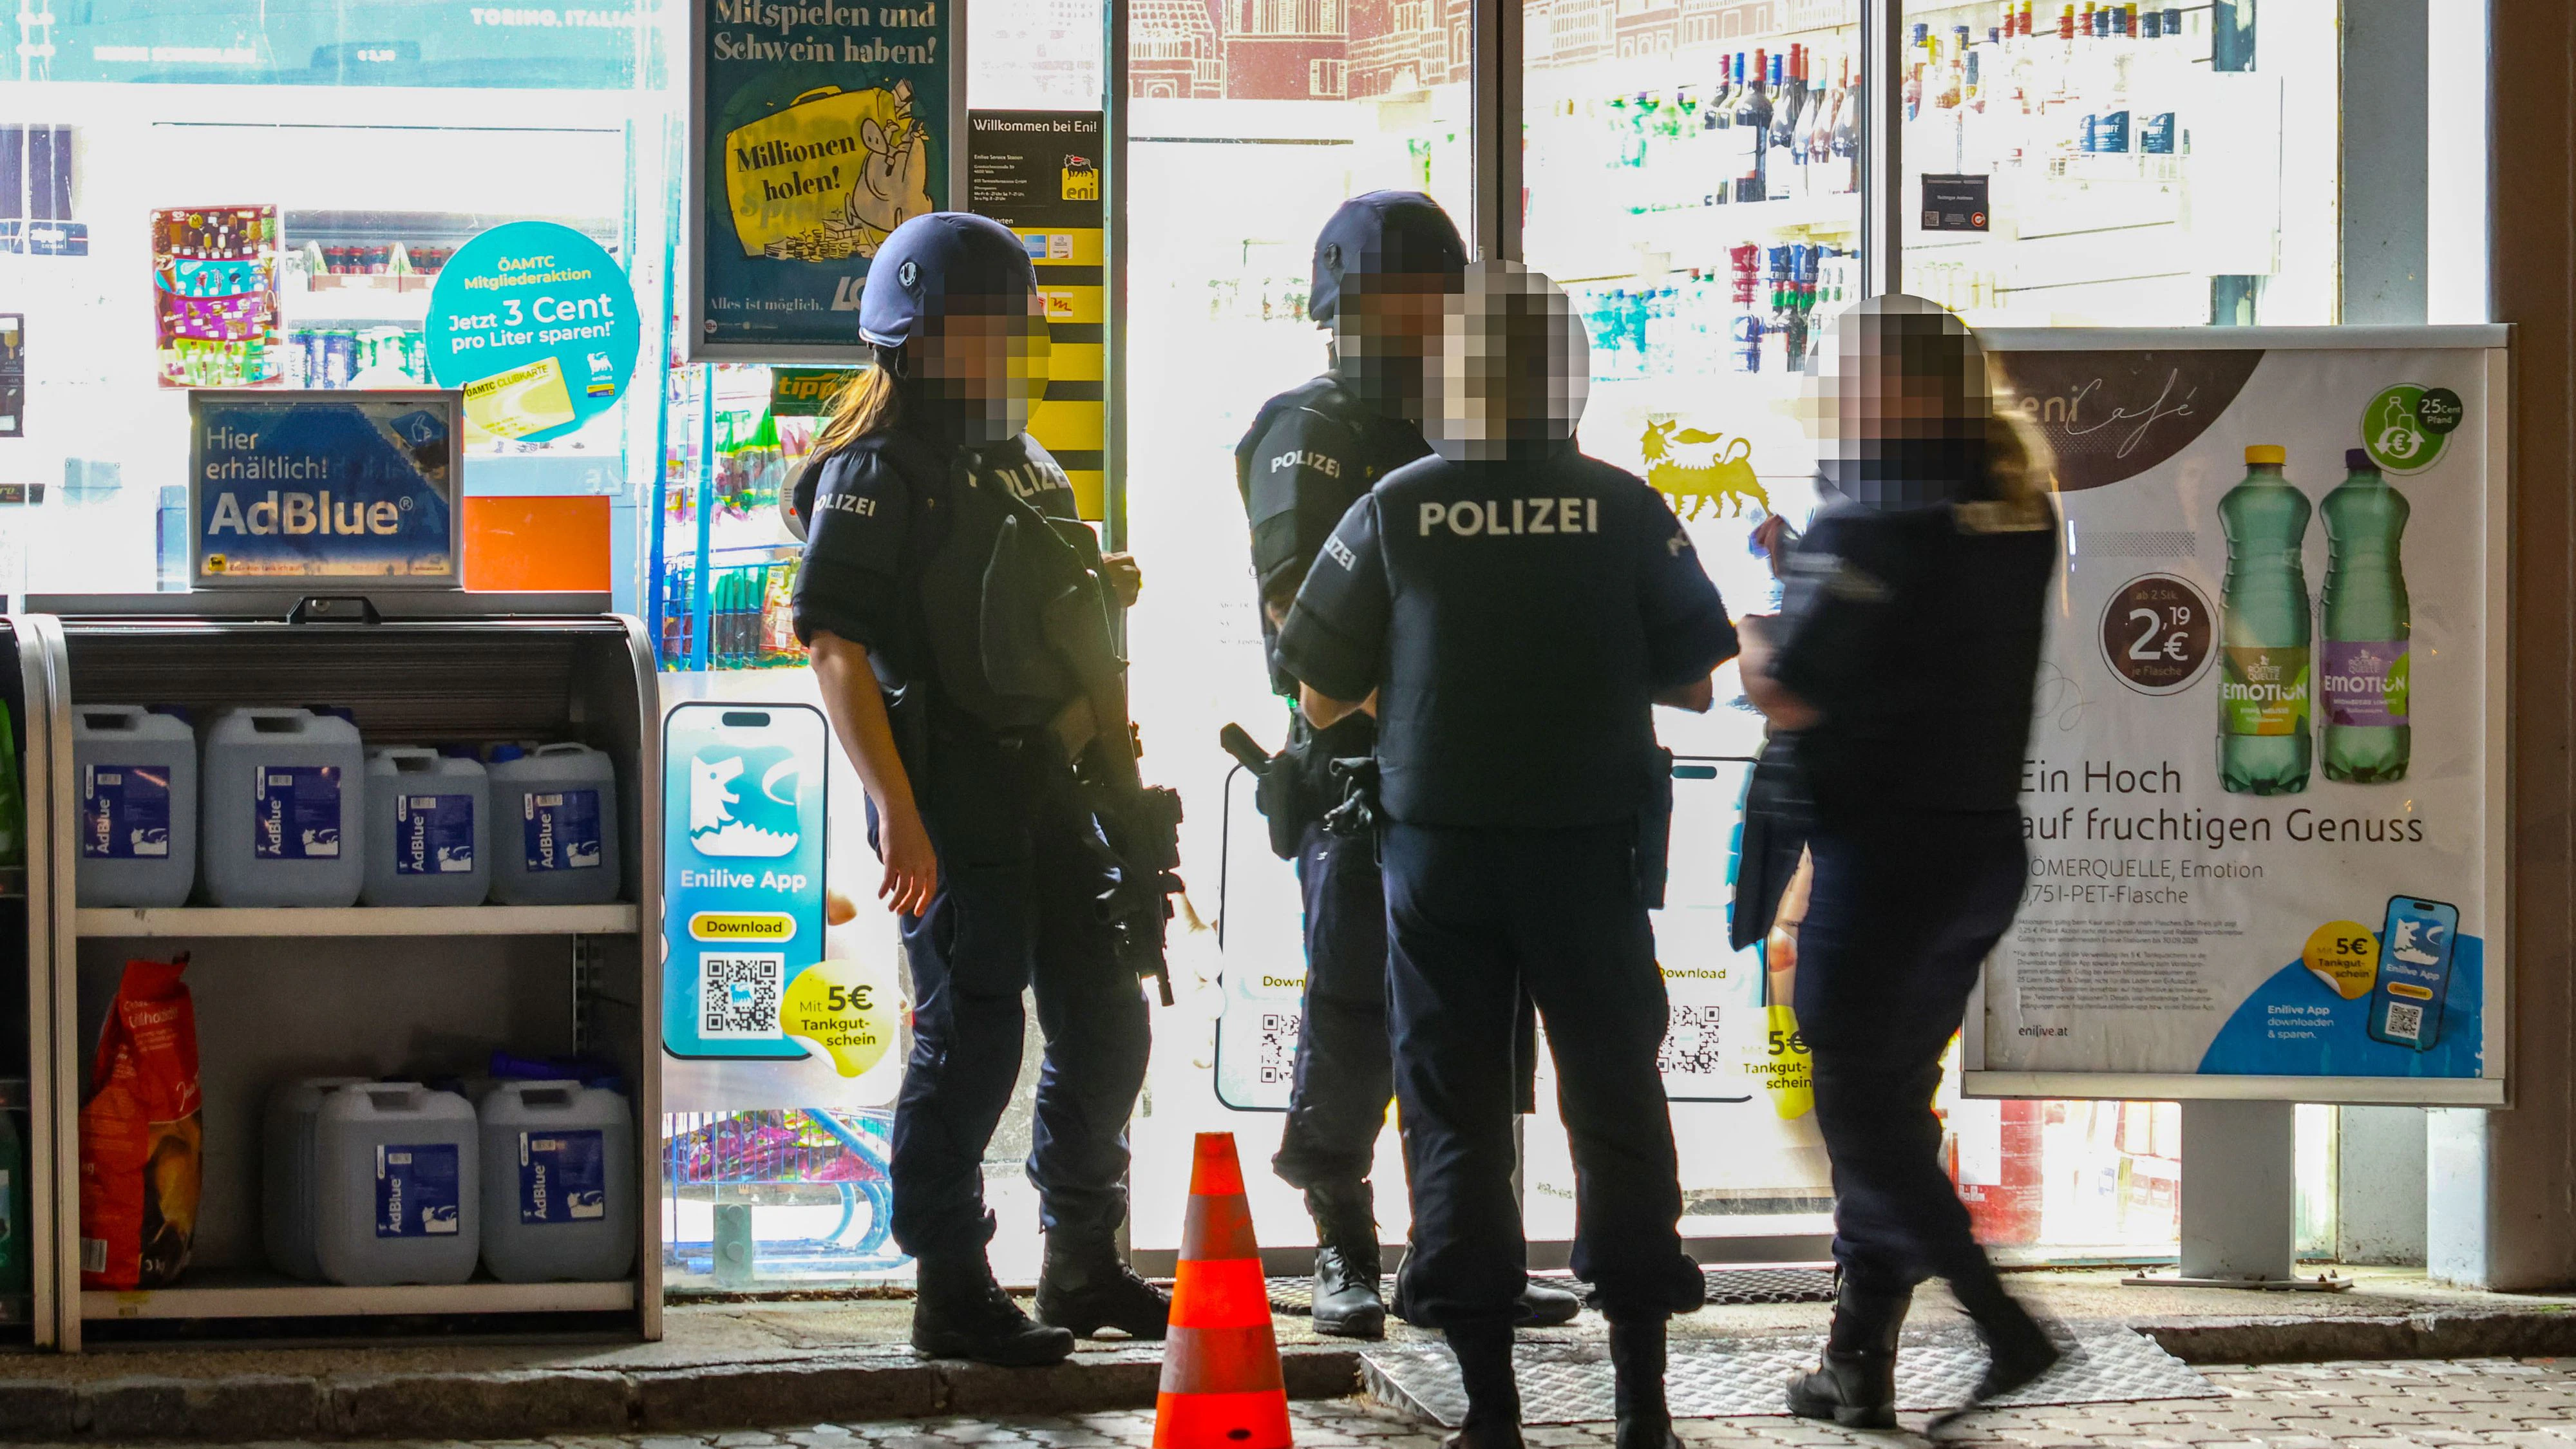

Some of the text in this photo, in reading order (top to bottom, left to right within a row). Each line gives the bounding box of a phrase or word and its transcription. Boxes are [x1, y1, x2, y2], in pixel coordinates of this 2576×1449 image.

[715, 0, 937, 35] Mitspielen und
[714, 32, 937, 64] Schwein haben!
[973, 119, 1097, 133] Willkommen bei Eni!
[734, 134, 856, 173] Millionen
[762, 166, 840, 202] holen!
[1066, 182, 1094, 199] eni
[498, 255, 556, 272] ÖAMTC
[464, 268, 592, 290] Mitgliederaktion
[449, 293, 614, 331] Jetzt 3 Cent
[746, 298, 761, 310] ist
[765, 298, 824, 314] möglich.
[451, 336, 486, 354] pro
[489, 329, 535, 348] Liter
[497, 364, 547, 389] CLUBKARTE
[2066, 368, 2196, 459] Café
[2427, 415, 2452, 424] Pfand
[206, 426, 259, 450] Hier
[206, 455, 327, 480] erhältlich!
[813, 491, 876, 518] POLIZEI
[1419, 498, 1598, 537] POLIZEI
[2152, 591, 2157, 599] 2
[2163, 631, 2189, 661] €
[2143, 665, 2182, 676] Flasche
[2248, 673, 2280, 681] QUELLE
[2223, 683, 2307, 701] EMOTION
[2325, 675, 2405, 693] EMOTION
[2021, 760, 2181, 793] Ein Hoch
[2022, 808, 2423, 849] auf fruchtigen Genuss
[2031, 855, 2264, 882] ÖMERQUELLE, Emotion
[681, 869, 808, 893] Enilive App
[706, 920, 782, 934] Download
[2336, 938, 2368, 956] 5€
[2318, 958, 2365, 969] Tankgut-
[2385, 964, 2440, 981] Enilive App
[1263, 976, 1304, 987] Down
[800, 985, 874, 1013] Mit 5€
[2267, 1005, 2331, 1016] Enilive App
[801, 1018, 870, 1032] Tankgut-
[2018, 1024, 2068, 1037] enilive.at
[2268, 1017, 2334, 1027] downloaden
[826, 1032, 876, 1046] schein
[1768, 1030, 1811, 1055] 5€
[2268, 1030, 2317, 1040] & sparen.
[1744, 1061, 1807, 1077] Tankgut-
[1766, 1075, 1812, 1089] schein
